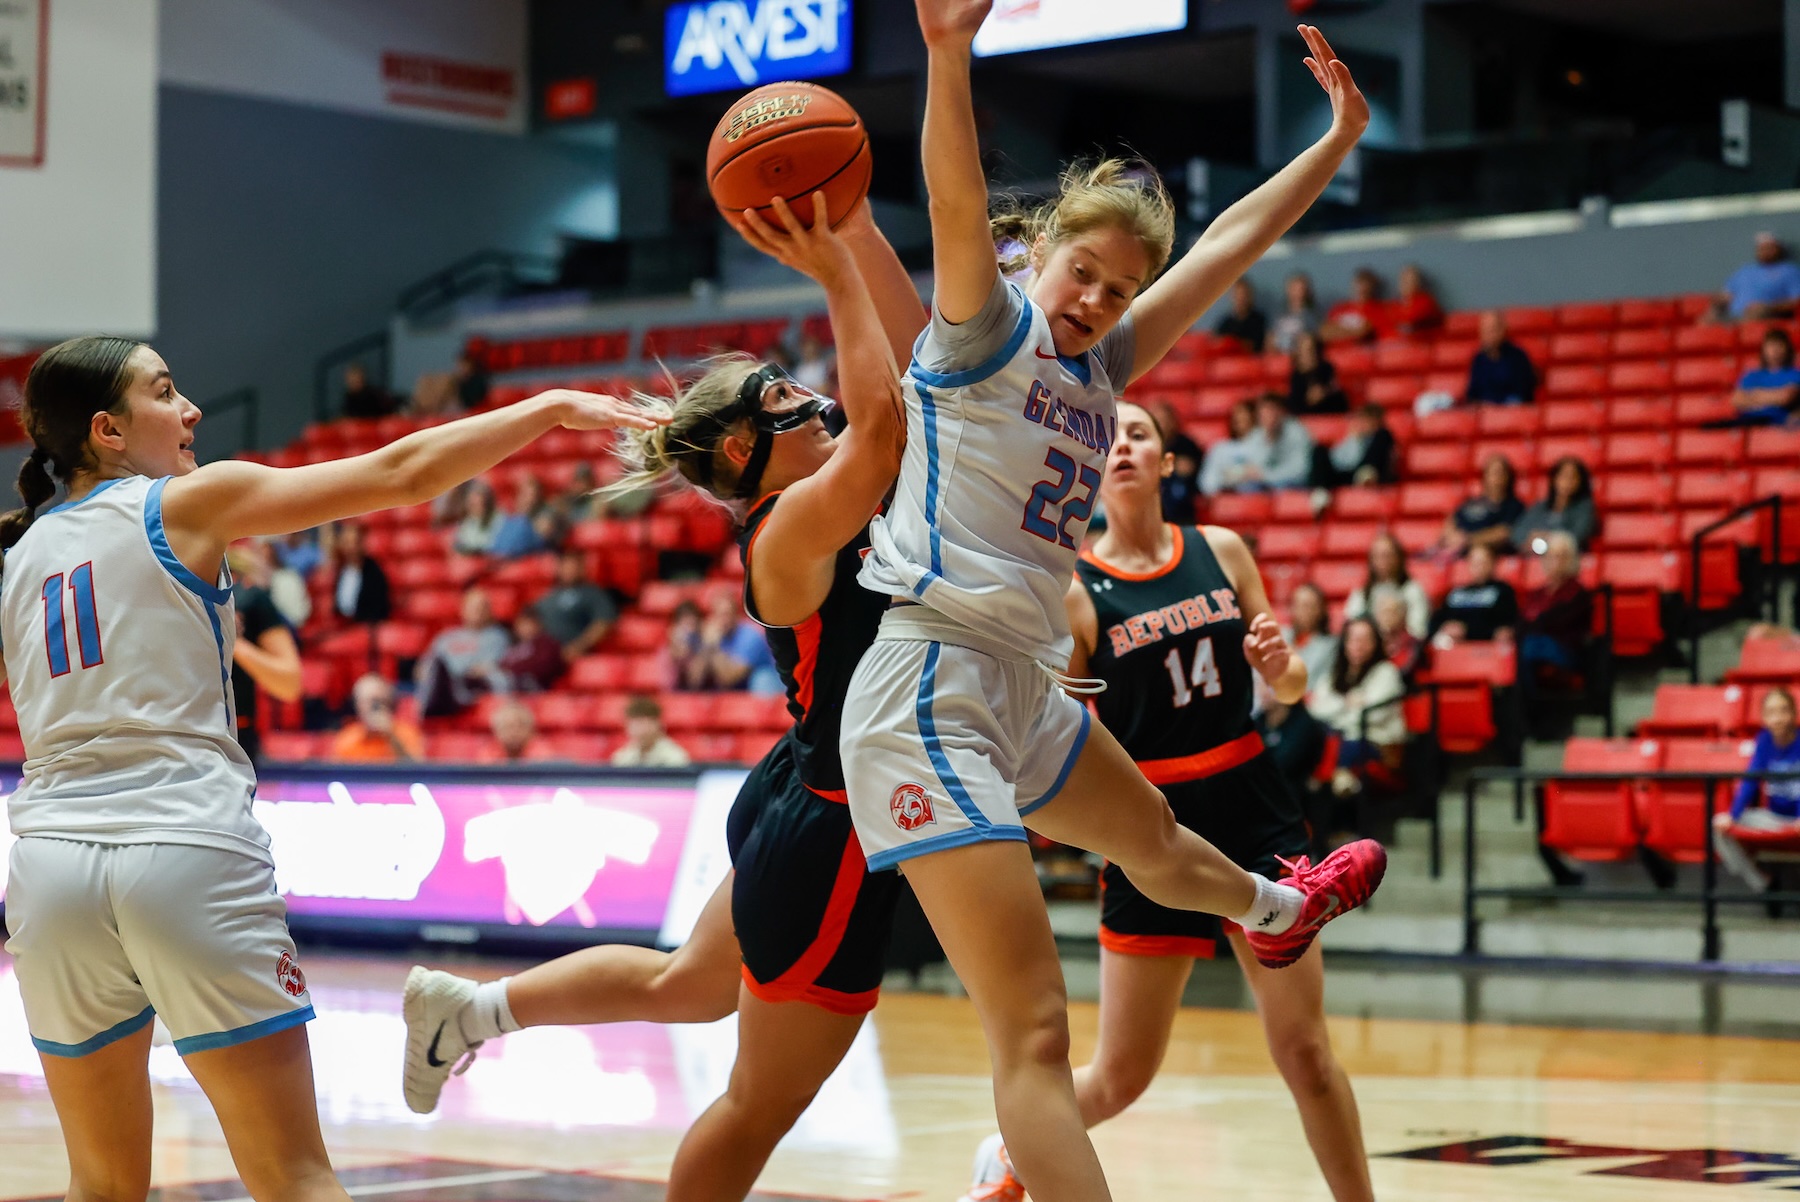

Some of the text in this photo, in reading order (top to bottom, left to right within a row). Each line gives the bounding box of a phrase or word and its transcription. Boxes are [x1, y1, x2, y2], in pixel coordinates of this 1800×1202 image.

[673, 0, 848, 85] ARVEST
[1021, 446, 1101, 551] 22
[42, 560, 104, 679] 11
[1107, 588, 1241, 658] REPUBLIC
[1164, 636, 1222, 708] 14
